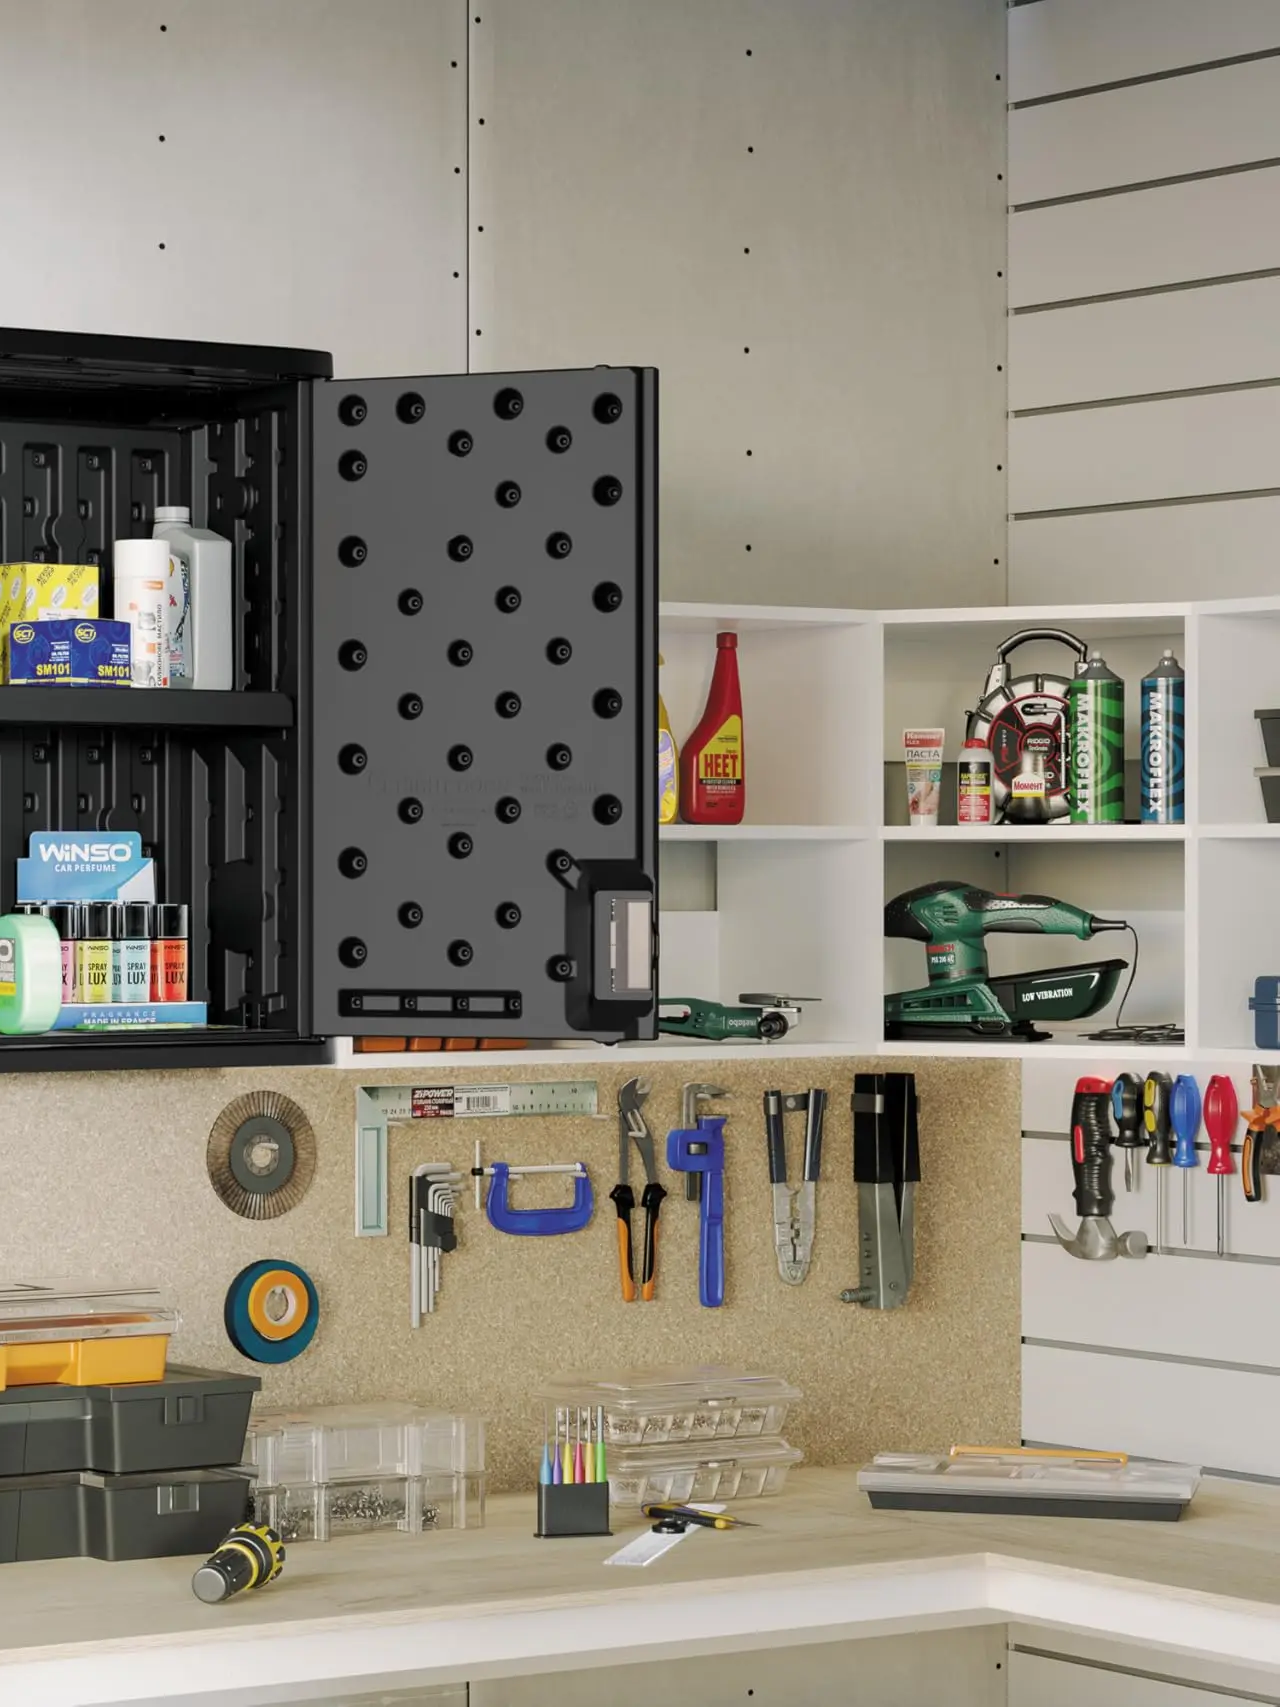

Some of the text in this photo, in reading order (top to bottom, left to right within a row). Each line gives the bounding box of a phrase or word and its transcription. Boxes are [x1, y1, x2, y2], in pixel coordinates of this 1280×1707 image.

[36, 663, 70, 676] SM101
[98, 665, 130, 678] SM101
[907, 750, 940, 758] ПАСТА
[1077, 693, 1090, 813] MAKROFLEX
[1150, 692, 1163, 813] MAKROFLEX
[704, 753, 738, 777] HEET
[74, 865, 117, 873] PERFUME
[88, 963, 107, 971] SPRAY
[127, 962, 146, 971] SPRAY
[165, 962, 184, 970] SPRAY
[88, 972, 107, 985] LUX
[128, 972, 146, 984] LUX
[166, 972, 185, 984] LUX
[1022, 988, 1073, 1002] LOW VIBRATION
[83, 1010, 156, 1018] FRAGRANCE
